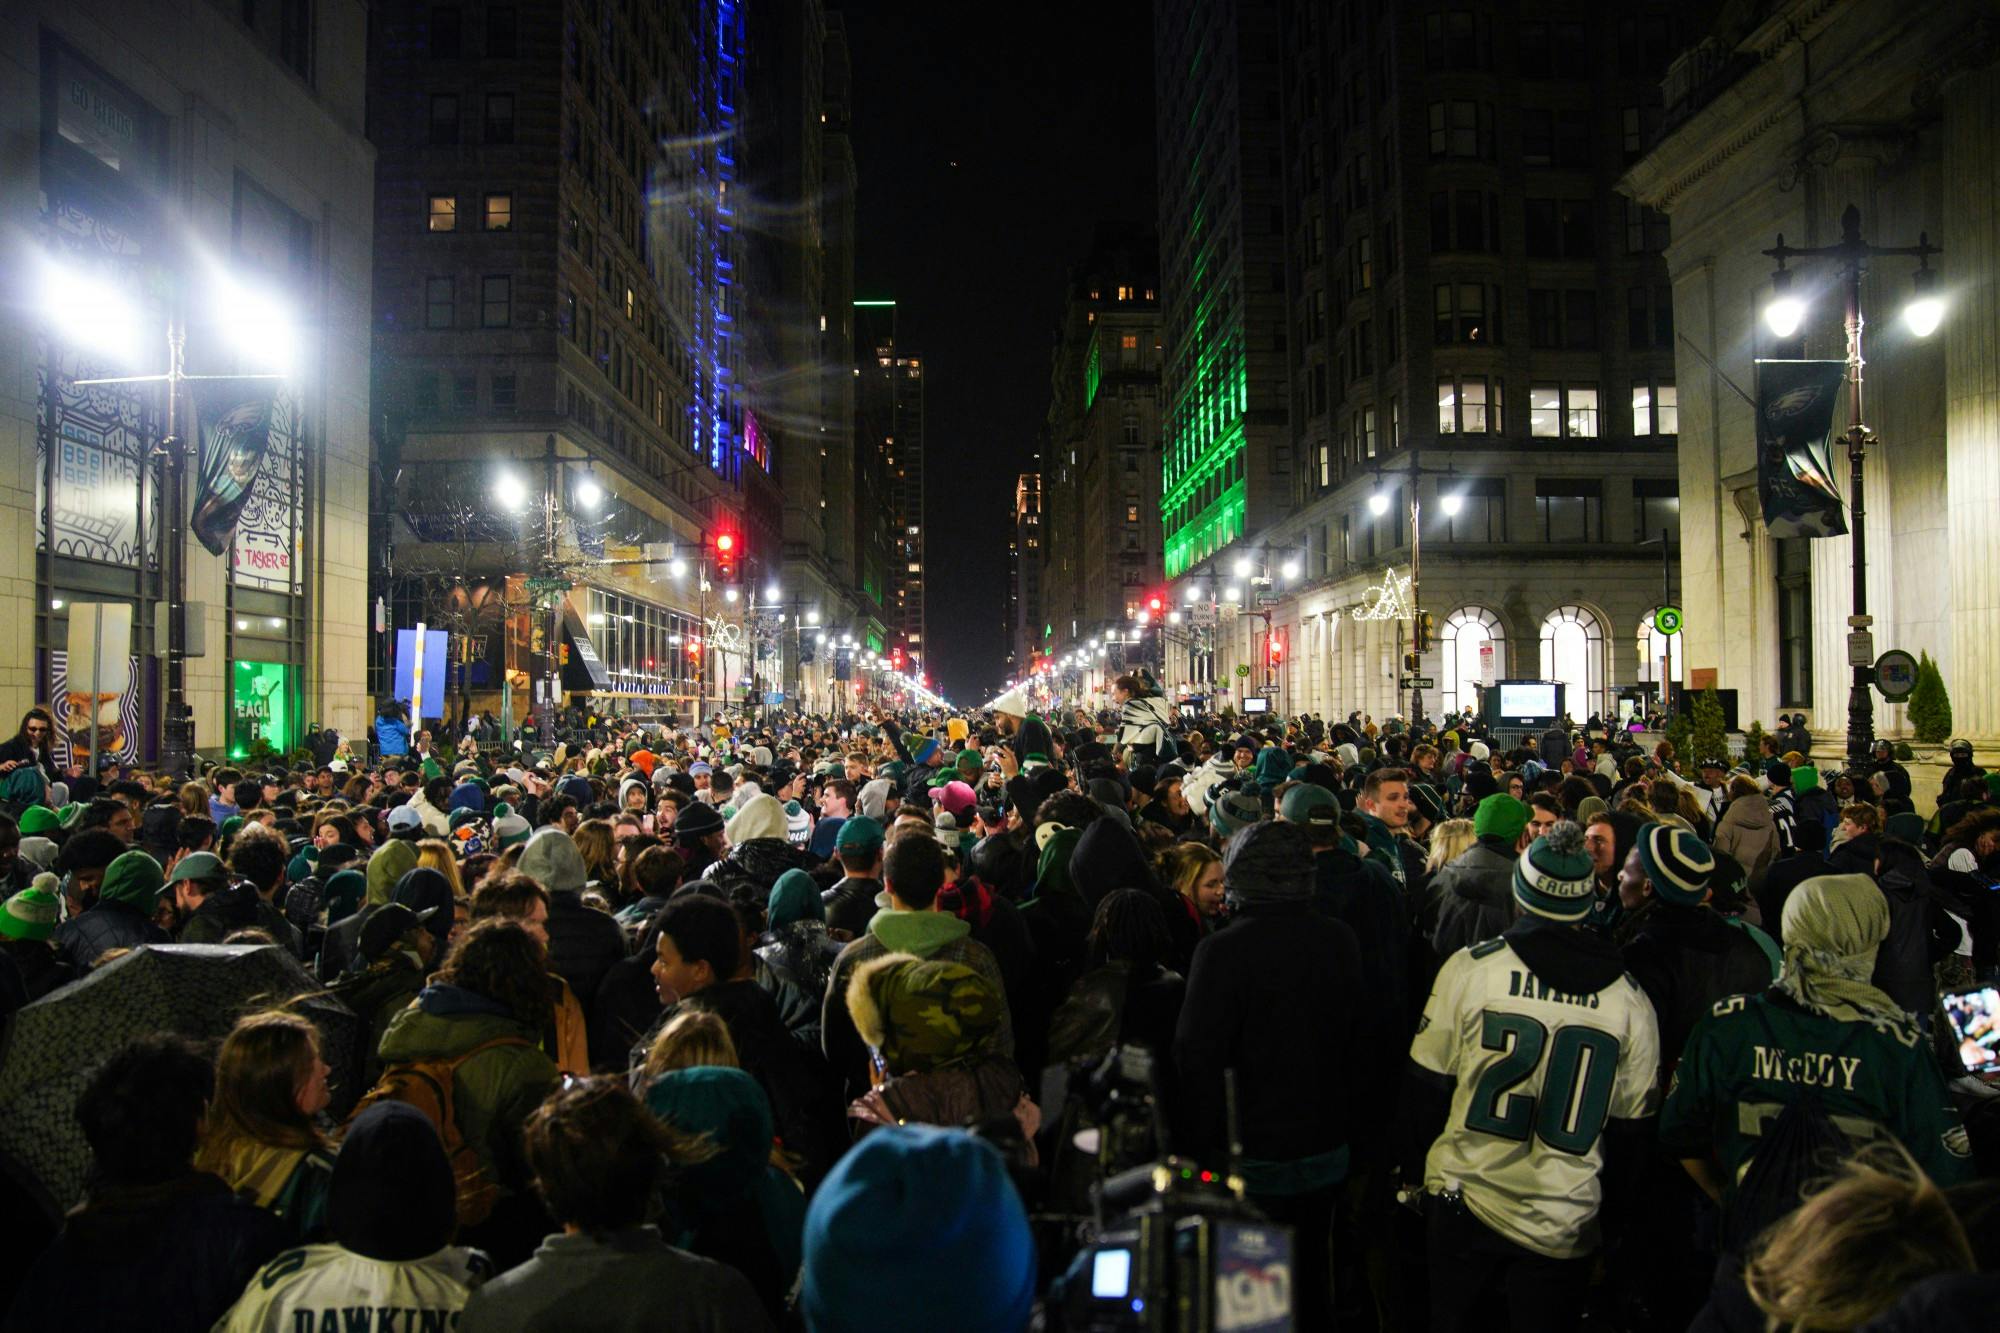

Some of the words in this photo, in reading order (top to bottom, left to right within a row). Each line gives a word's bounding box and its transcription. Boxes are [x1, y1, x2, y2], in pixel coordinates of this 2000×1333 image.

[71, 80, 89, 111] GO
[245, 549, 279, 570] TASKER
[1198, 603, 1210, 612] NO
[1465, 1009, 1620, 1156] 20
[1752, 1045, 1862, 1092] McCOY
